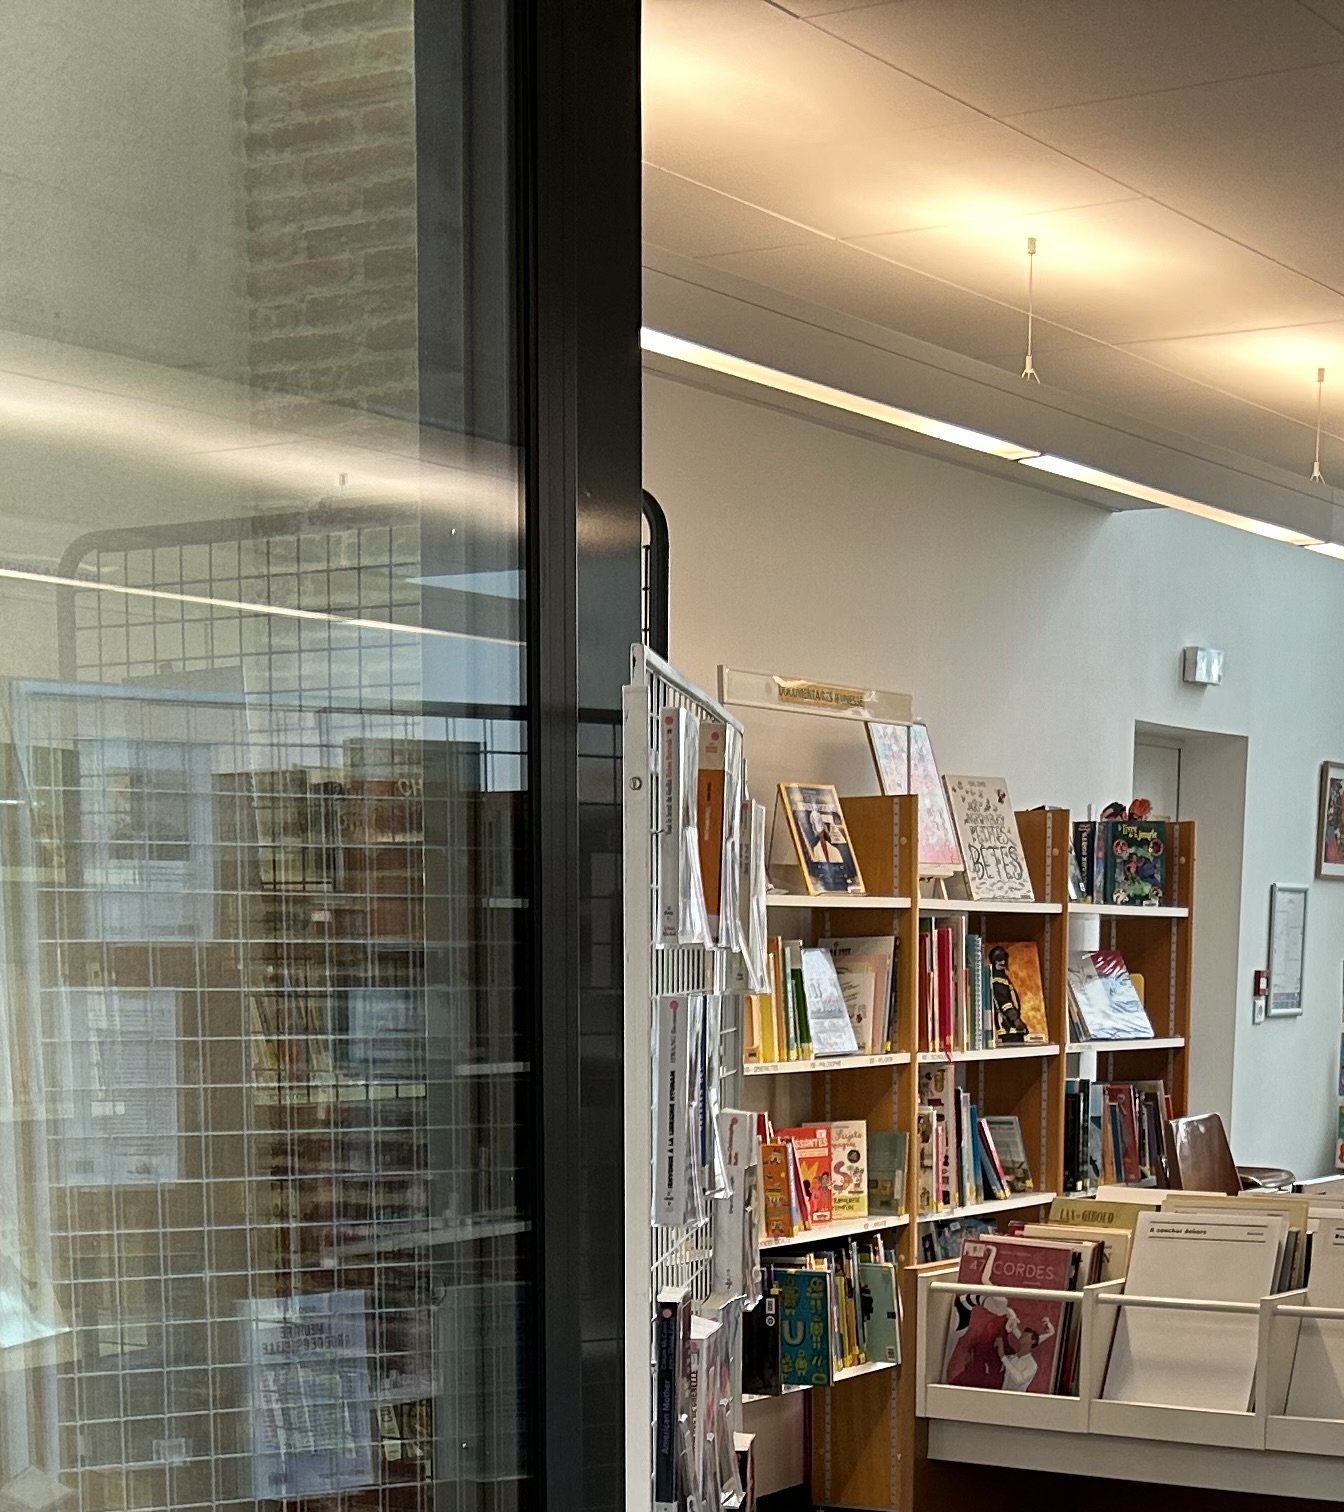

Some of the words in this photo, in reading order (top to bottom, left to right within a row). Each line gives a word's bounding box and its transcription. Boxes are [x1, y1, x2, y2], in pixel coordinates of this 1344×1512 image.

[992, 1260, 1055, 1281] CORDES
[659, 1379, 670, 1411] Mother
[659, 1412, 670, 1454] American
